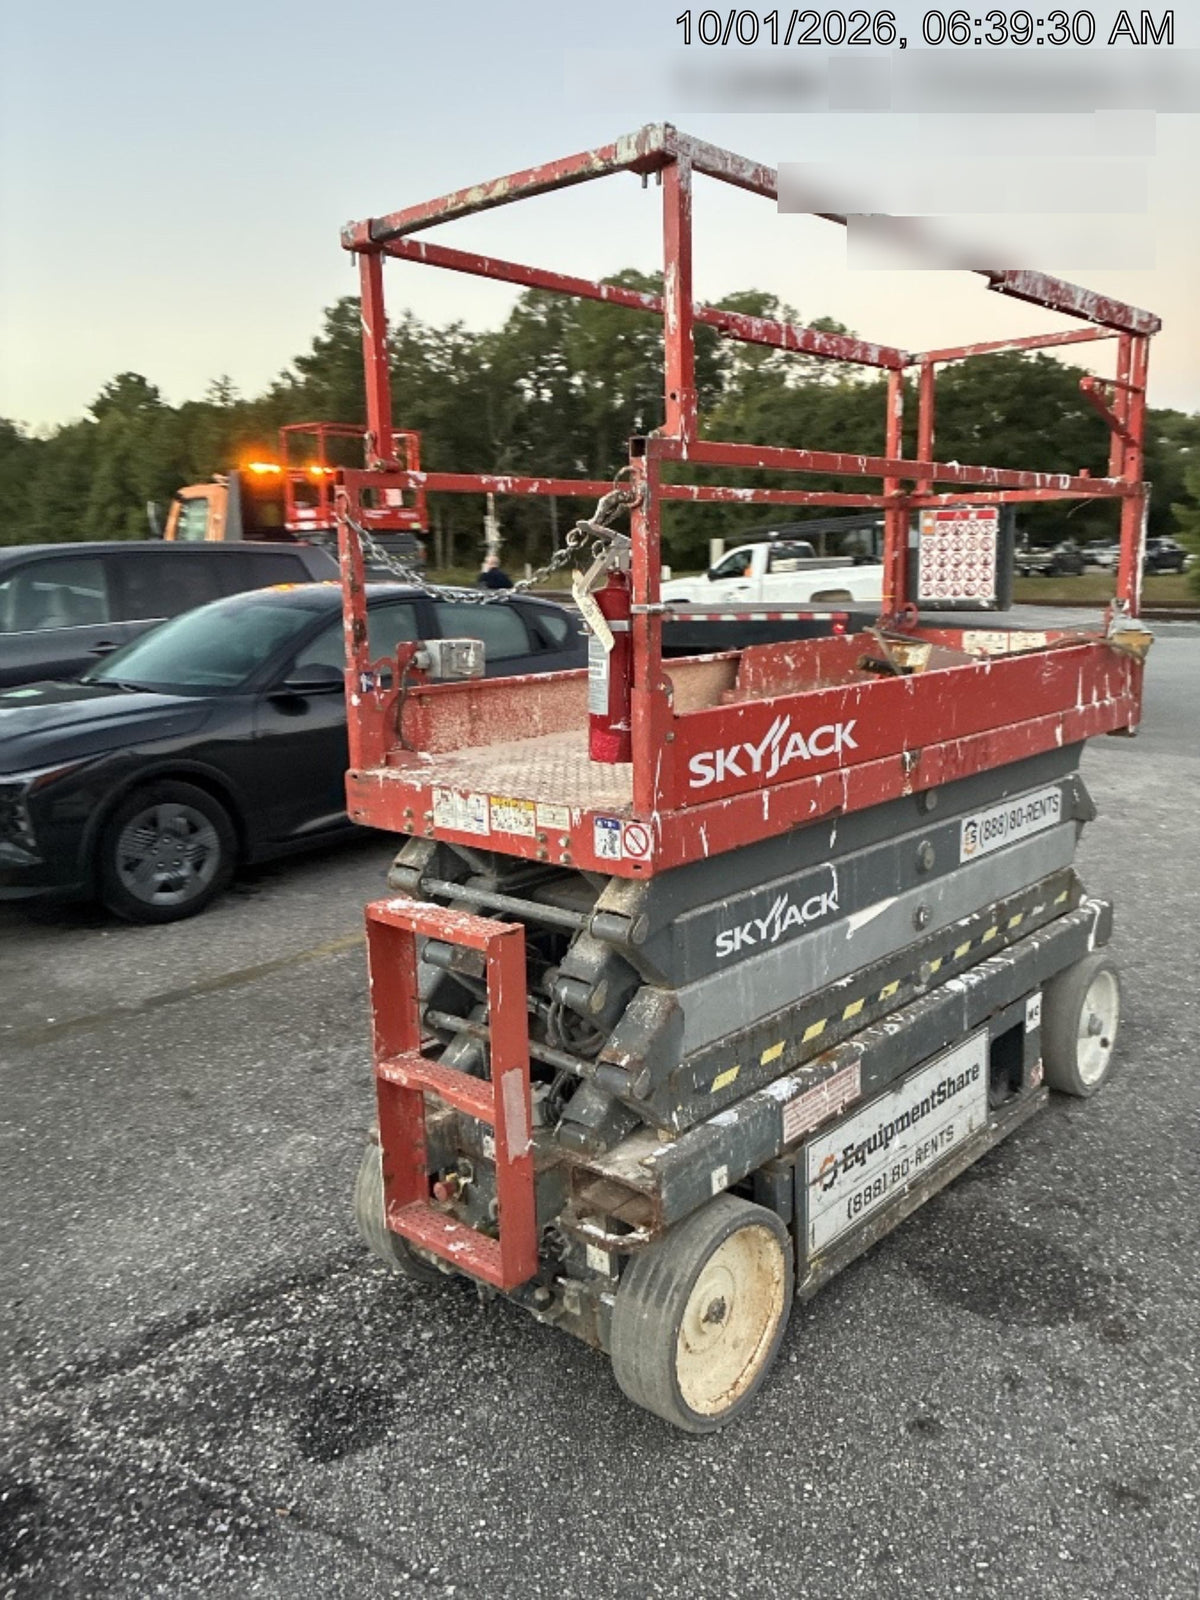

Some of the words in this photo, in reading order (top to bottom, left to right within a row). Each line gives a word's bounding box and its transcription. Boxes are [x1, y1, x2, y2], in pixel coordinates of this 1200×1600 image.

[688, 713, 859, 788] SKYJACK
[715, 891, 840, 958] SKYJACK
[842, 1062, 980, 1174] EquipmentShare
[891, 1124, 955, 1184] 80-RENTS
